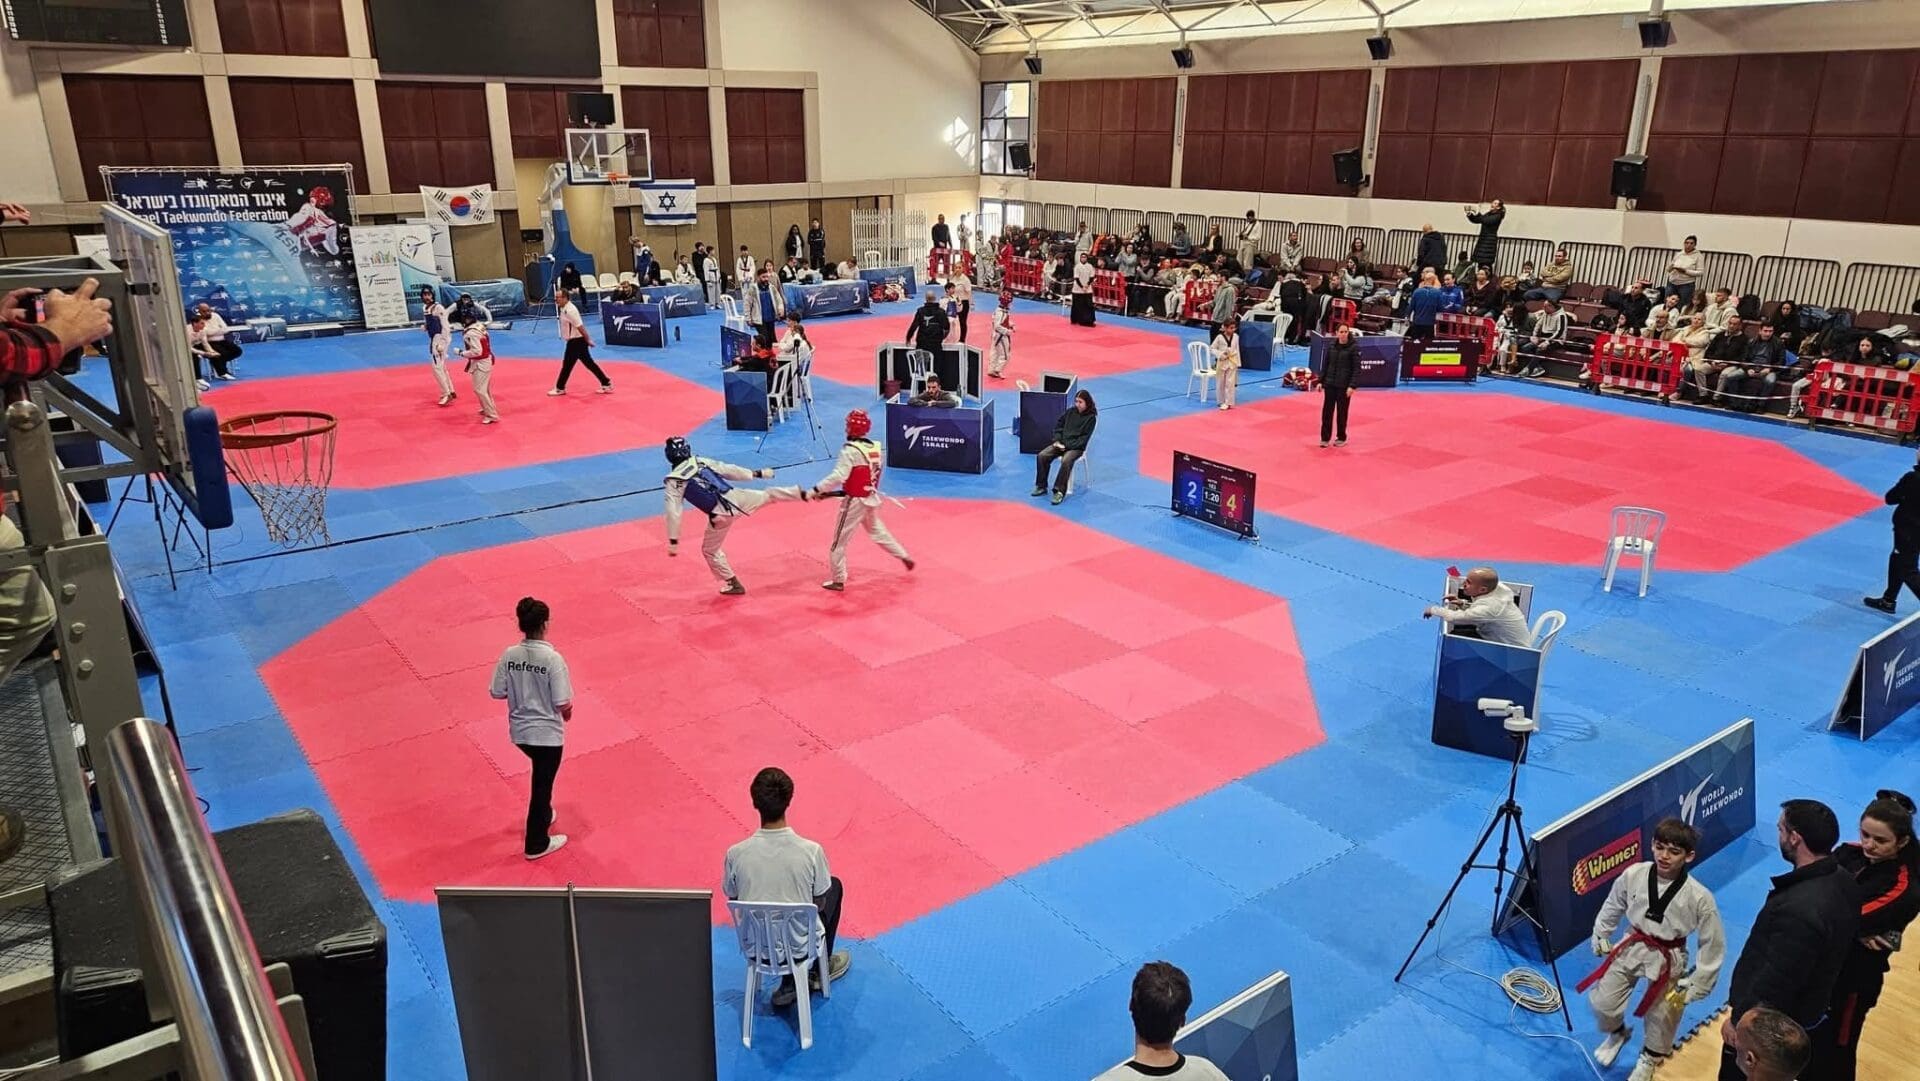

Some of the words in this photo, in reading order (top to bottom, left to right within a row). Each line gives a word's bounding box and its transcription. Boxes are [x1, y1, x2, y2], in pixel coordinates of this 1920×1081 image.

[121, 193, 178, 209] בישראל
[251, 193, 287, 207] איגוד
[161, 210, 227, 224] Taekwondo
[229, 208, 289, 221] Federation
[853, 287, 861, 304] 3
[922, 435, 965, 445] TAEKWONDO
[1187, 481, 1197, 499] 2
[1226, 494, 1237, 512] 4
[507, 661, 548, 675] Referee
[1701, 785, 1726, 807] WORLD
[1702, 786, 1744, 819] TAEKWONDO
[1587, 842, 1639, 879] Winner
